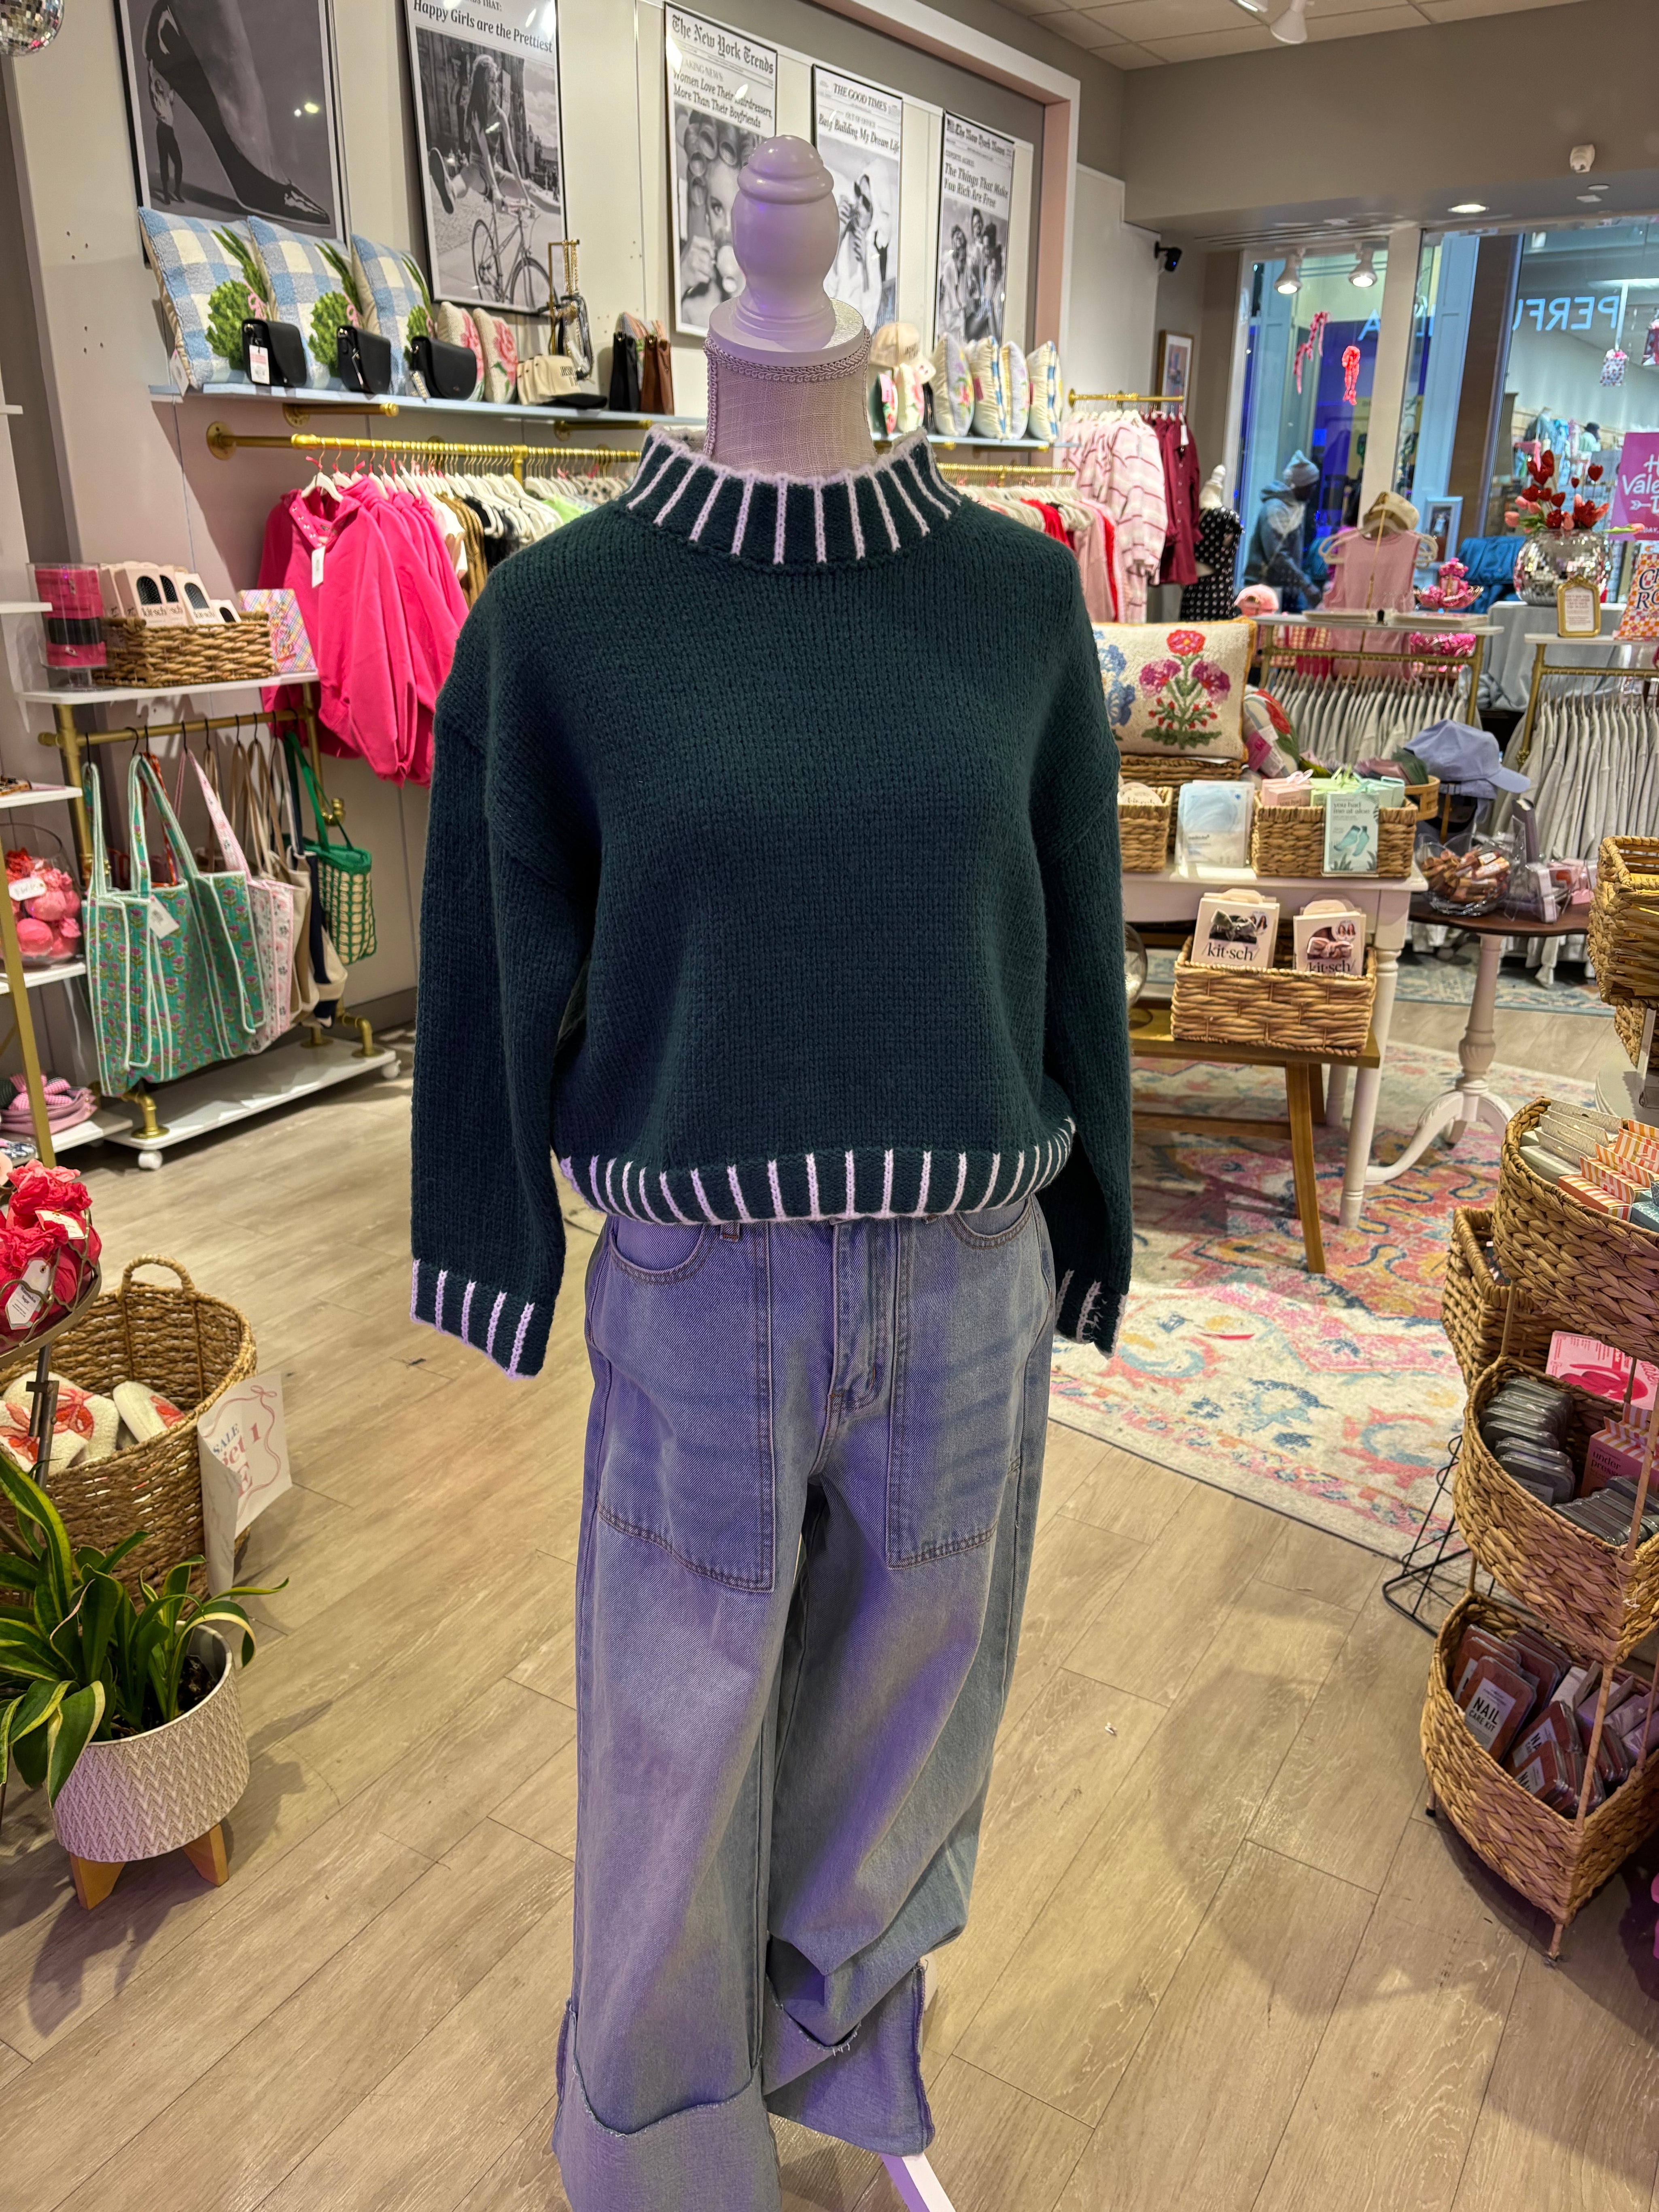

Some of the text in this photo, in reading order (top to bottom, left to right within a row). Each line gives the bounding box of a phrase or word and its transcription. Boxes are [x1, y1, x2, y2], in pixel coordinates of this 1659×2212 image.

[414, 0, 553, 53] Happy Girls are the Prettiest
[672, 15, 691, 38] The
[694, 24, 715, 48] New
[717, 34, 740, 59] York
[744, 46, 774, 74] Trends
[1593, 1451, 1621, 1470] under
[1469, 1710, 1496, 1732] CARE KIT
[1473, 1696, 1499, 1725] NAIL
